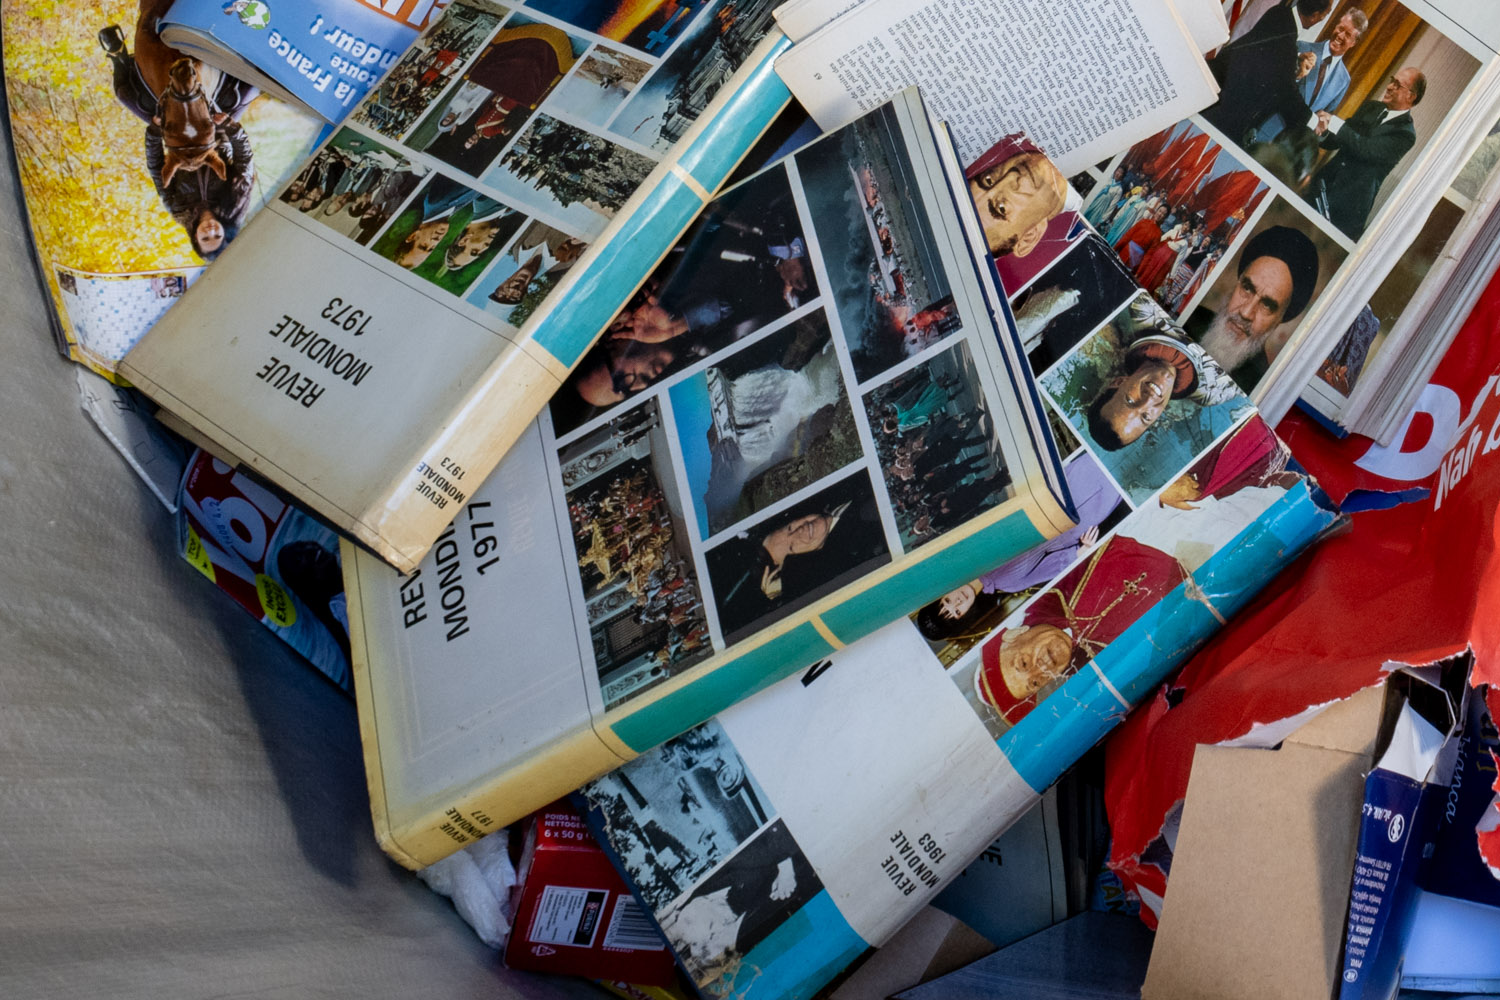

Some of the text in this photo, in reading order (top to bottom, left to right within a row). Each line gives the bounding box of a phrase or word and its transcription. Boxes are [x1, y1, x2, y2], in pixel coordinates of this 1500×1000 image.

[322, 24, 396, 68] ndeur
[1128, 14, 1149, 44] survient
[266, 29, 356, 105] la France
[329, 54, 377, 88] toute
[1148, 50, 1174, 88] printemps
[320, 295, 372, 334] 1973
[268, 314, 372, 386] MONDIALE
[256, 356, 325, 408] REVUE
[416, 461, 465, 503] MONDIALE
[440, 456, 465, 480] 1973
[1434, 430, 1482, 511] Nah
[415, 481, 448, 509] REVUE
[468, 500, 494, 575] 1977
[400, 567, 427, 628] REV
[433, 522, 470, 641] MONDI
[440, 821, 468, 844] REVUE
[445, 807, 486, 840] MONDIALE
[471, 808, 493, 826] 1977
[544, 829, 574, 838] 6 50
[889, 829, 940, 888] MONDIALE
[917, 832, 945, 864] 1963
[880, 855, 916, 896] REVUE
